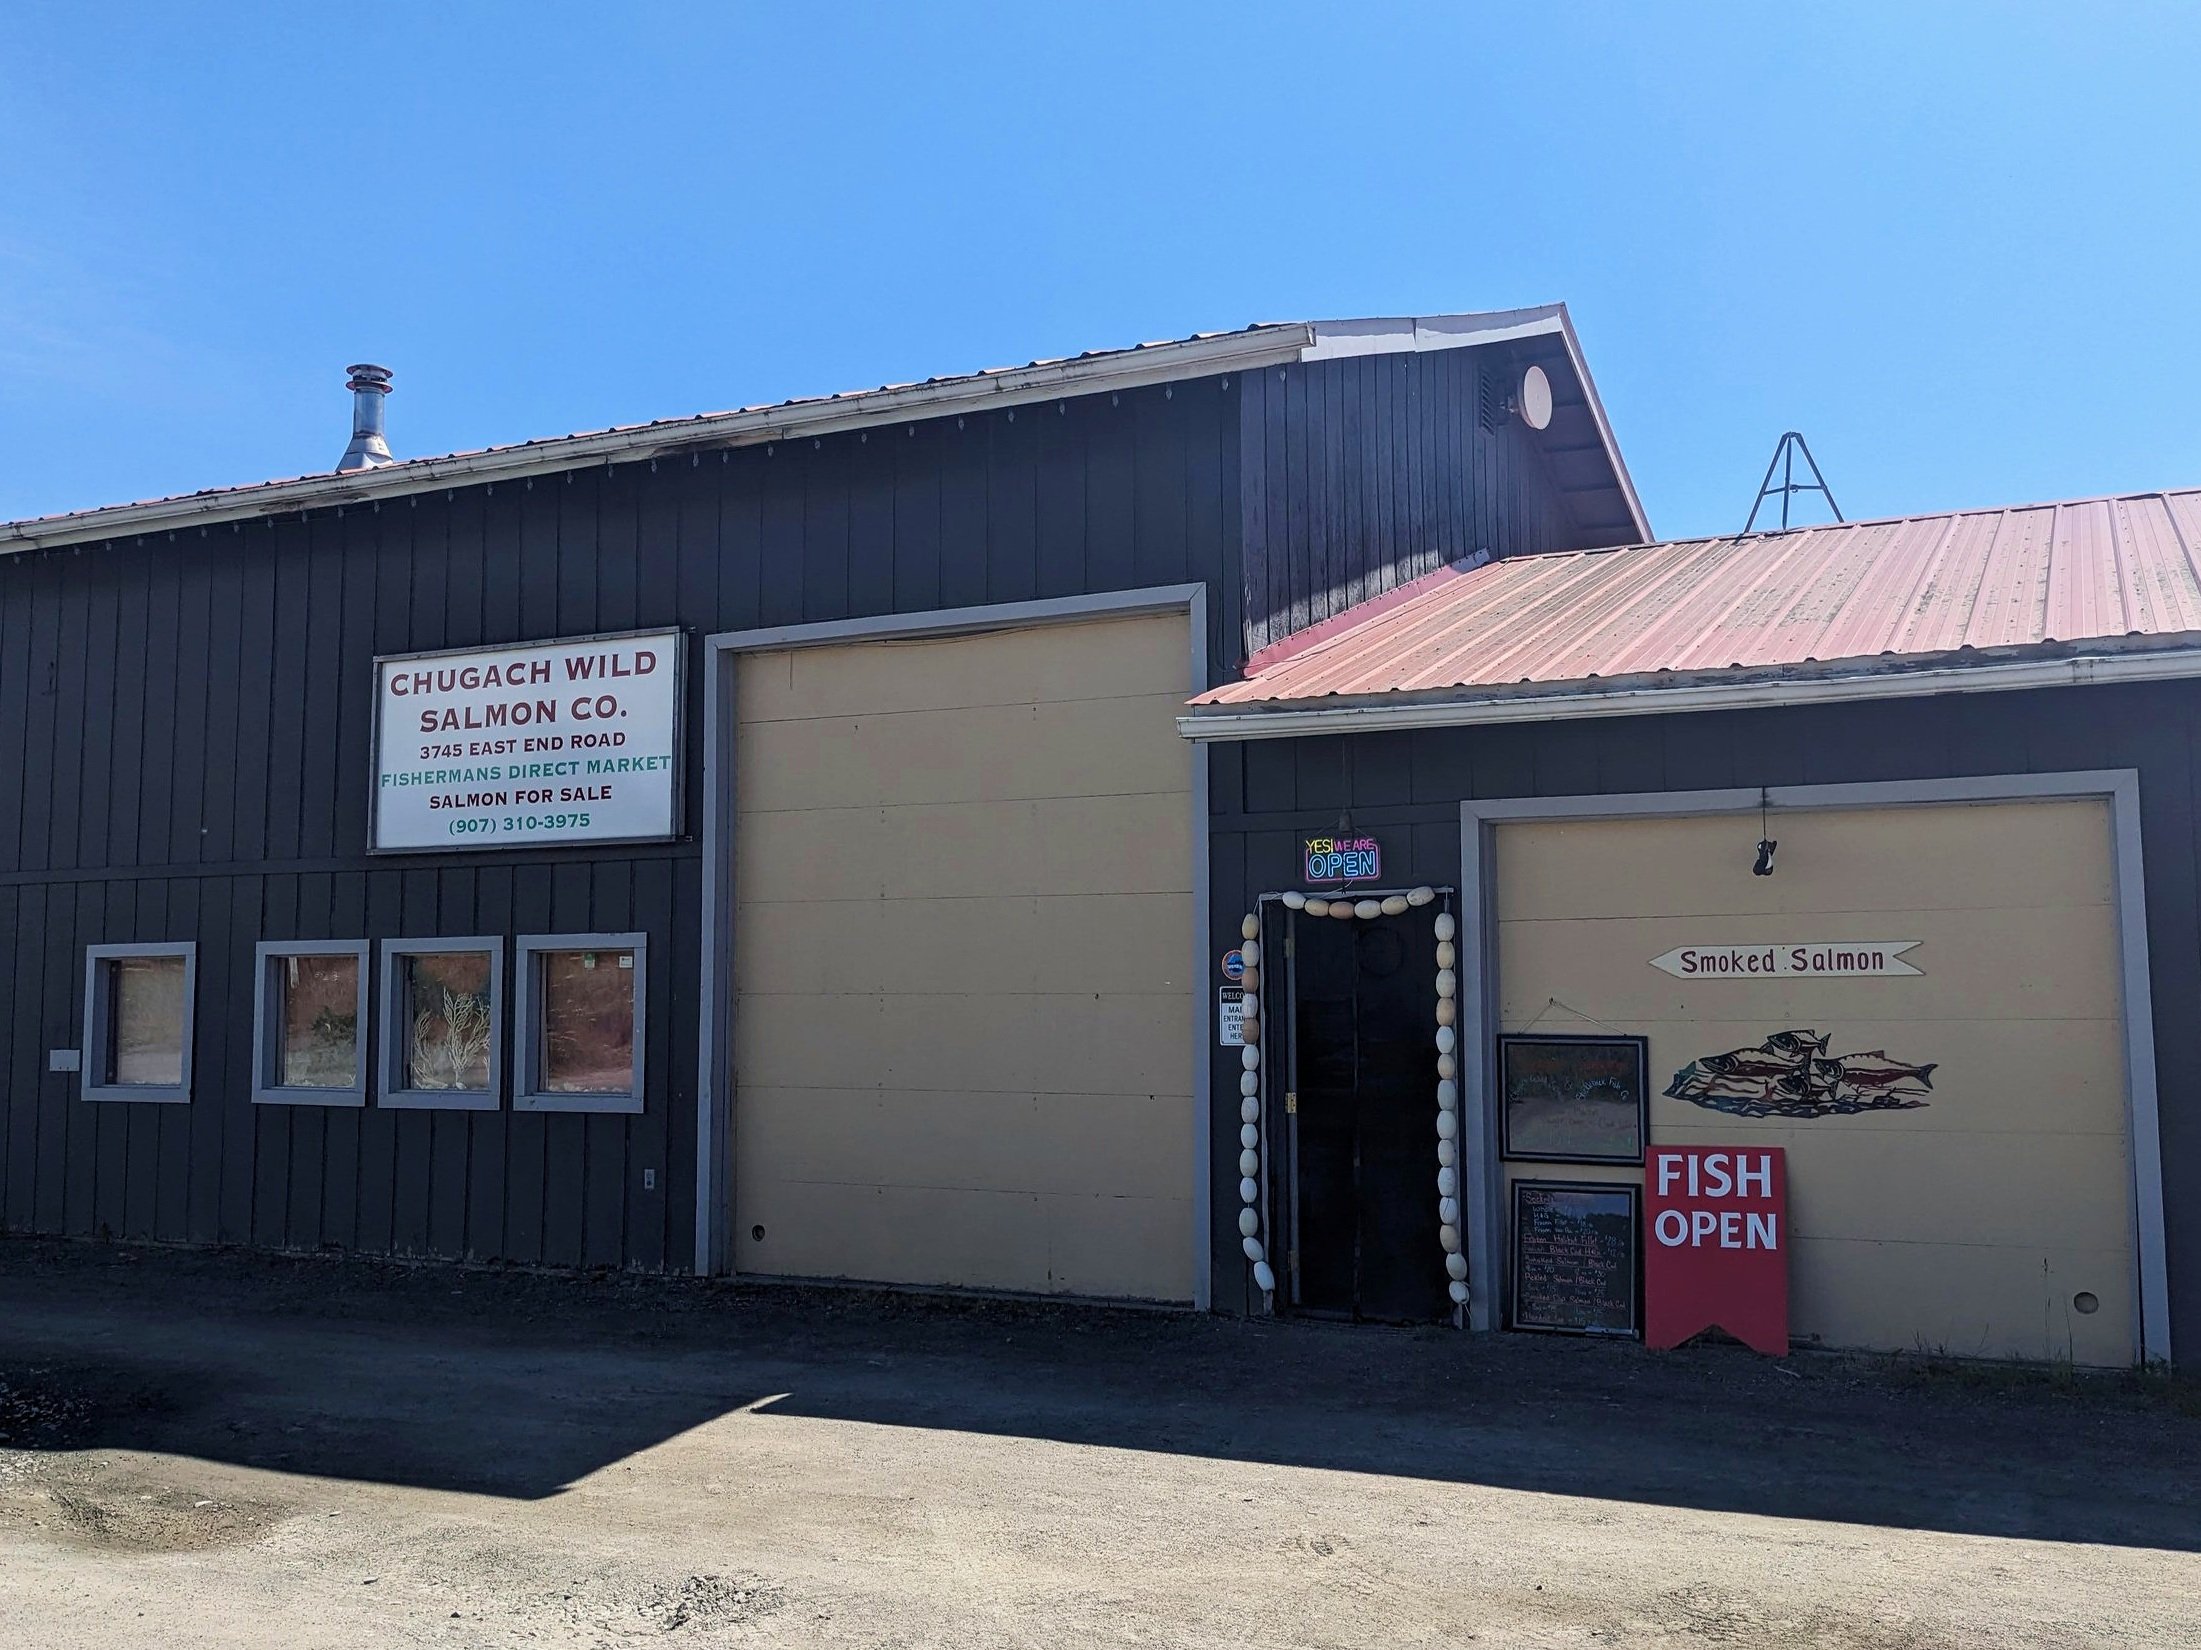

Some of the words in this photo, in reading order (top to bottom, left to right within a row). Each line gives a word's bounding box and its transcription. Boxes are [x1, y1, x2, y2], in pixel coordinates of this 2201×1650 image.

[390, 659, 551, 697] CHUGACH
[564, 651, 657, 681] WILD
[420, 699, 557, 733] SALMON
[571, 695, 627, 721] CO.
[420, 744, 463, 760] 3745
[469, 739, 517, 756] EAST
[523, 736, 564, 753] END
[571, 732, 627, 749] ROAD
[381, 766, 502, 788] FISHERMANS
[508, 761, 580, 781] DIRECT
[586, 755, 672, 775] MARKET
[429, 791, 508, 810] SALMON
[515, 789, 553, 805] FOR
[560, 785, 613, 802] SALE
[449, 818, 497, 836] (907)
[503, 813, 591, 832] 310-3975
[1306, 838, 1334, 854] YES!
[1334, 840, 1351, 851] WE
[1353, 838, 1374, 851] ARE
[1309, 850, 1376, 878] OPEN
[1680, 949, 1776, 973] Smoked
[1790, 948, 1884, 972] Salmon
[1222, 992, 1244, 1000] WELCO
[1224, 1015, 1244, 1023] ENTRAN
[1228, 1023, 1244, 1031] ENTE
[1230, 1031, 1243, 1039] HER
[1657, 1153, 1772, 1198] FISH
[1654, 1209, 1777, 1250] OPEN
